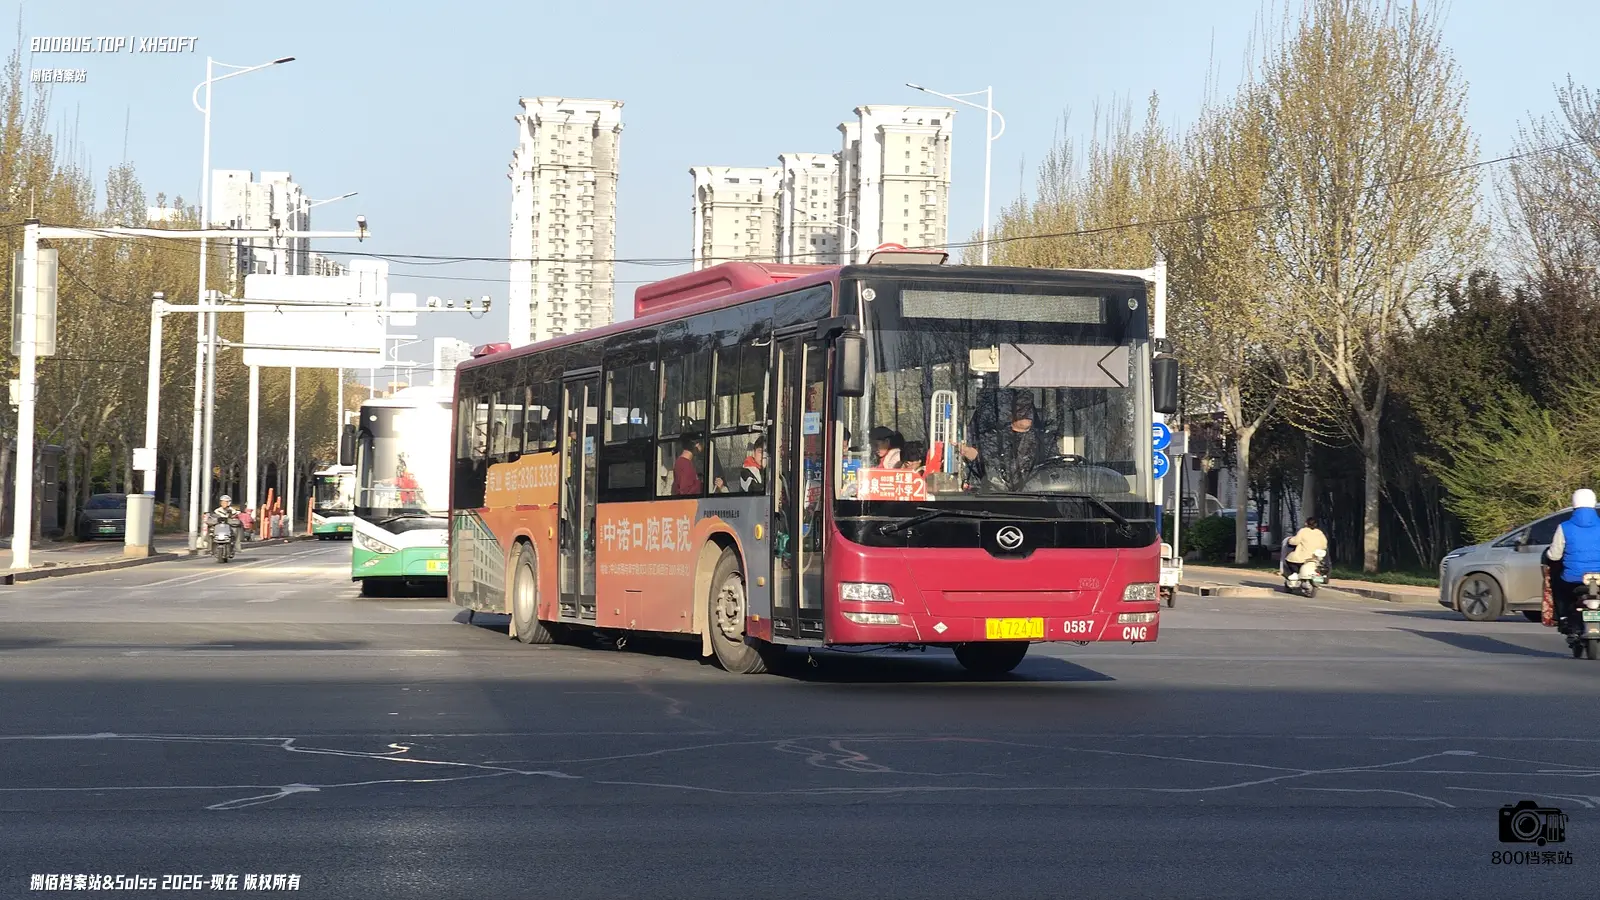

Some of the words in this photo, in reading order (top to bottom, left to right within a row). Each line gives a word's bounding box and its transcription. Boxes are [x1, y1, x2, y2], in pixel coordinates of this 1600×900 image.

[913, 478, 925, 497] 2
[603, 515, 692, 552] 中诺口腔医院
[1063, 620, 1095, 633] 0587
[1122, 626, 1147, 640] CNG
